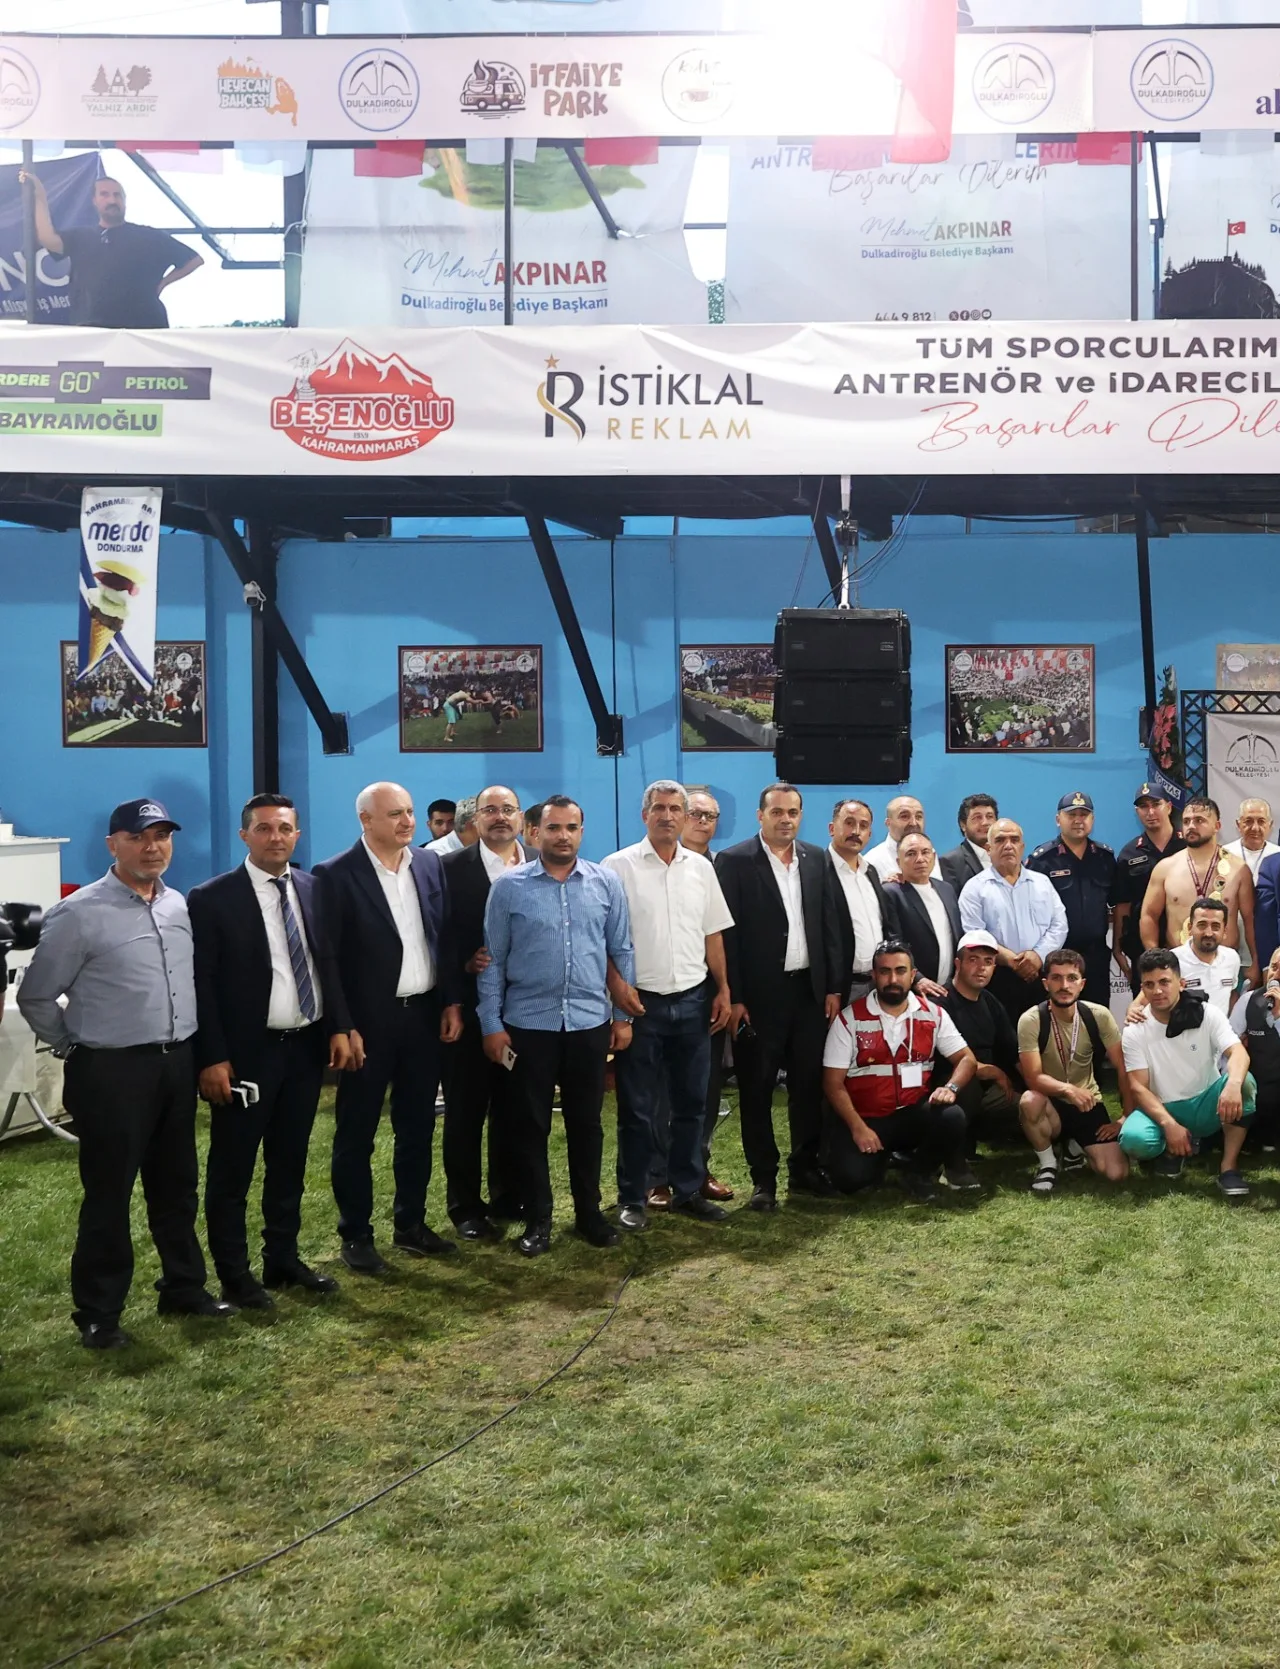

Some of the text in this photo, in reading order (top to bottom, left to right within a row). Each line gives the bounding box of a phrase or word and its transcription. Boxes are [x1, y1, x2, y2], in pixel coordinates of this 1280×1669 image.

[218, 78, 272, 94] HEYECAN
[530, 62, 623, 88] İTFAİYE
[346, 97, 413, 108] DULKADİROĞLU
[1138, 87, 1206, 98] DULKADİROĞLU
[543, 90, 609, 119] PARK
[860, 215, 1012, 241] Mehmet AKPINAR
[861, 244, 1014, 260] Dulkadiroğlu Belediye Başkanı
[403, 248, 505, 287] Mehmet
[401, 293, 608, 314] Dulkadiroğlu Beediye Başkanı
[912, 312, 932, 321] 812
[916, 337, 994, 359] TÜM
[59, 371, 92, 394] GO
[125, 376, 189, 390] PETROL
[598, 364, 764, 406] İSTİKLAL
[833, 367, 1042, 394] ANTRENÖR
[1055, 374, 1096, 394] ve
[0, 409, 158, 431] BAYRAMOĞLU
[274, 395, 450, 435] BEŞENOĞLU
[917, 399, 1120, 452] Başarılar
[607, 417, 752, 441] REKLAM
[300, 435, 420, 455] KAHRAMANMARAŞ
[88, 520, 153, 542] merdo
[97, 543, 144, 553] DONDURMA
